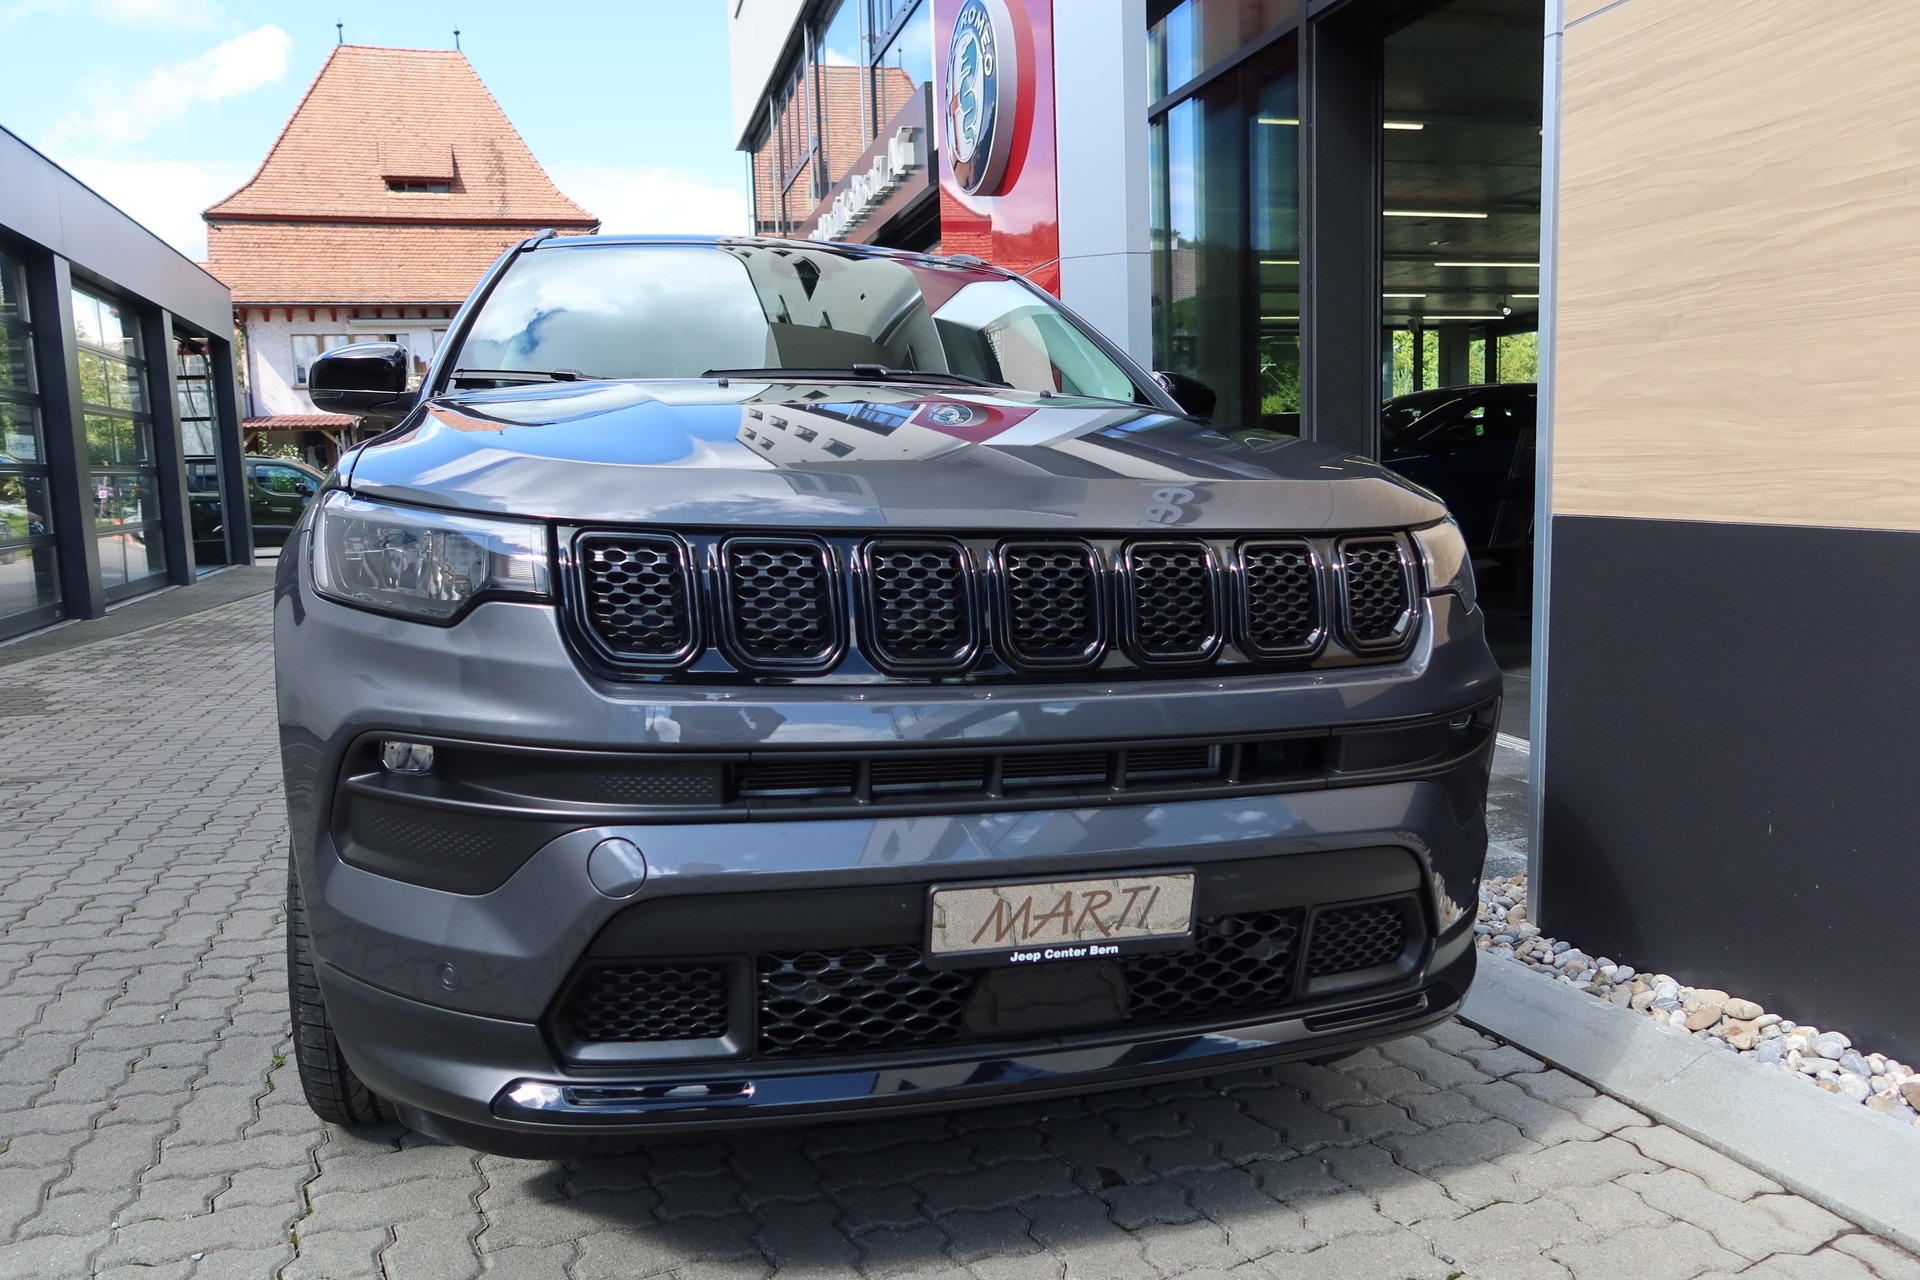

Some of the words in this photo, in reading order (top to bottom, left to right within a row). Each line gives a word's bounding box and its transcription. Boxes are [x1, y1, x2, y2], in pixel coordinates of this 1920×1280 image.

[961, 5, 993, 76] ROMEO
[971, 885, 1161, 945] MARTI
[1010, 952, 1041, 963] Jeep
[1044, 947, 1087, 959] Center
[1090, 944, 1119, 956] Bern
